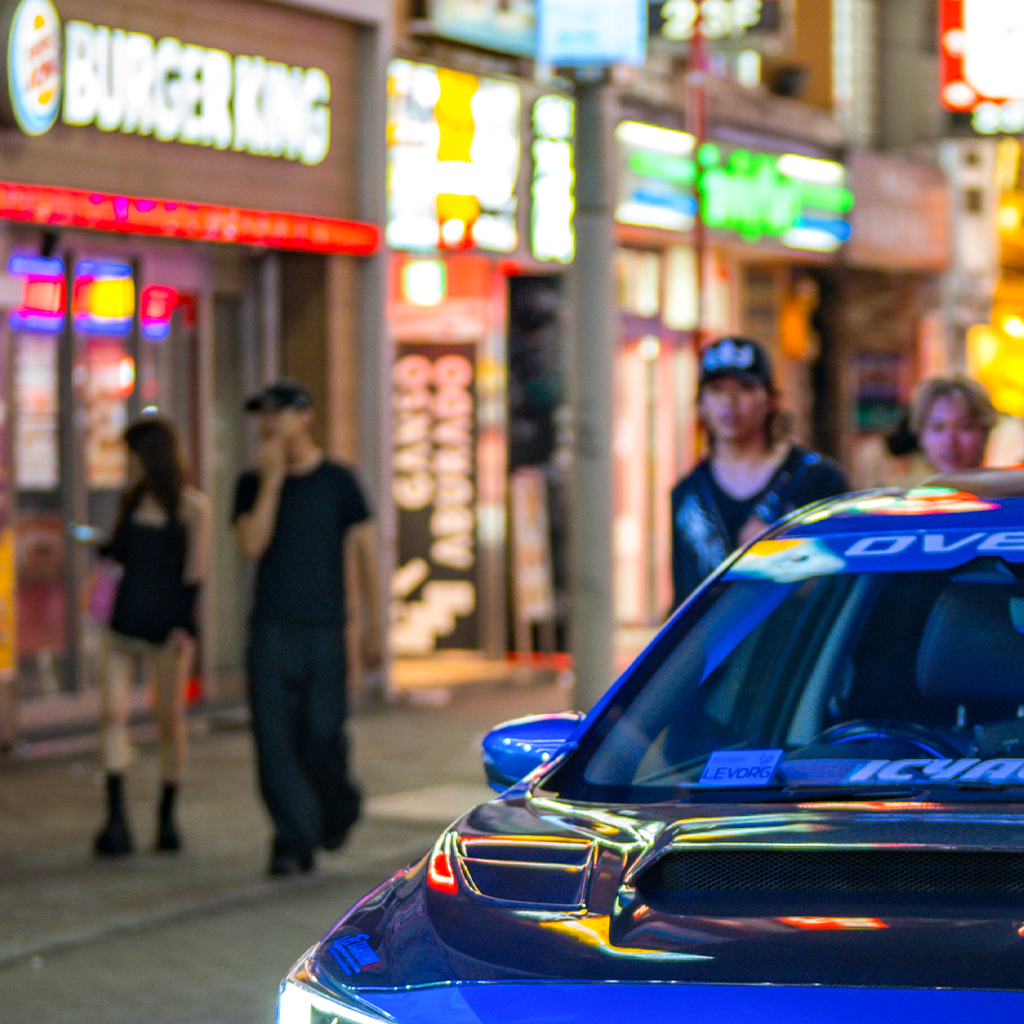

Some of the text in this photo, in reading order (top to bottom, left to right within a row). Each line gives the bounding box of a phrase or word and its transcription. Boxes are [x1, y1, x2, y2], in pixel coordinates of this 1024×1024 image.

[63, 19, 233, 150] BURGER
[231, 54, 330, 166] KING
[702, 766, 773, 780] LEVORG
